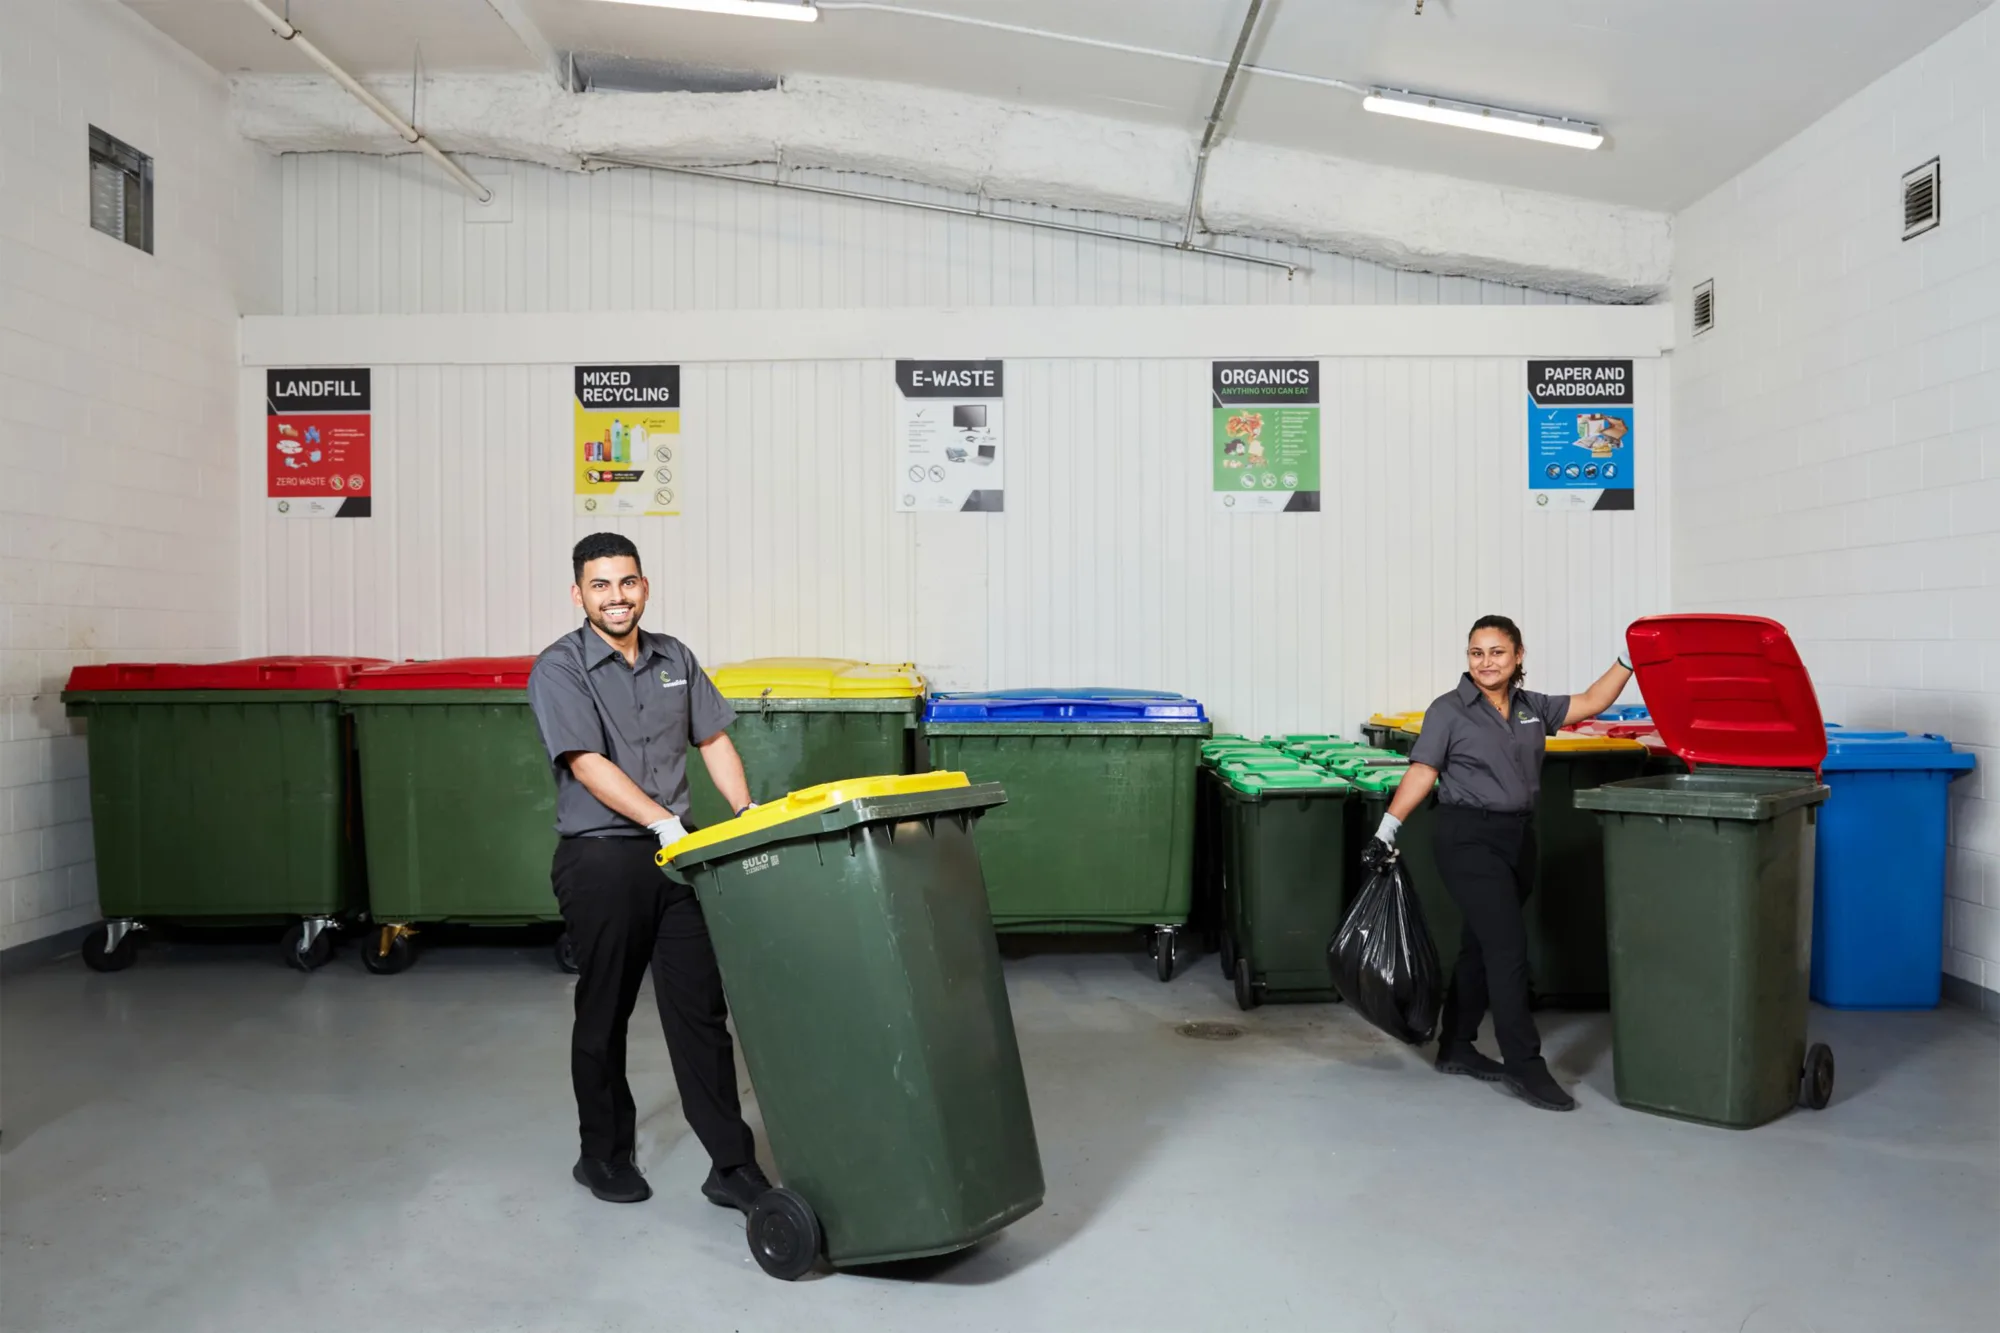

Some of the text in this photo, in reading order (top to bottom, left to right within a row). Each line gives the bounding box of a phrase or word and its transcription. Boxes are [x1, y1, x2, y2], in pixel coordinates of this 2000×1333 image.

[583, 371, 631, 386] MIXED
[912, 370, 995, 387] E-WASTE
[1220, 369, 1310, 385] ORGANICS
[1545, 367, 1625, 381] PAPER AND
[275, 380, 362, 398] LANDFILL
[583, 388, 670, 402] RECYCLING
[1221, 387, 1309, 395] ANYTHING YOU CAN EAT
[1536, 383, 1626, 397] CARDBOARD
[276, 477, 326, 487] ZERO WASTE
[742, 853, 769, 869] SULO
